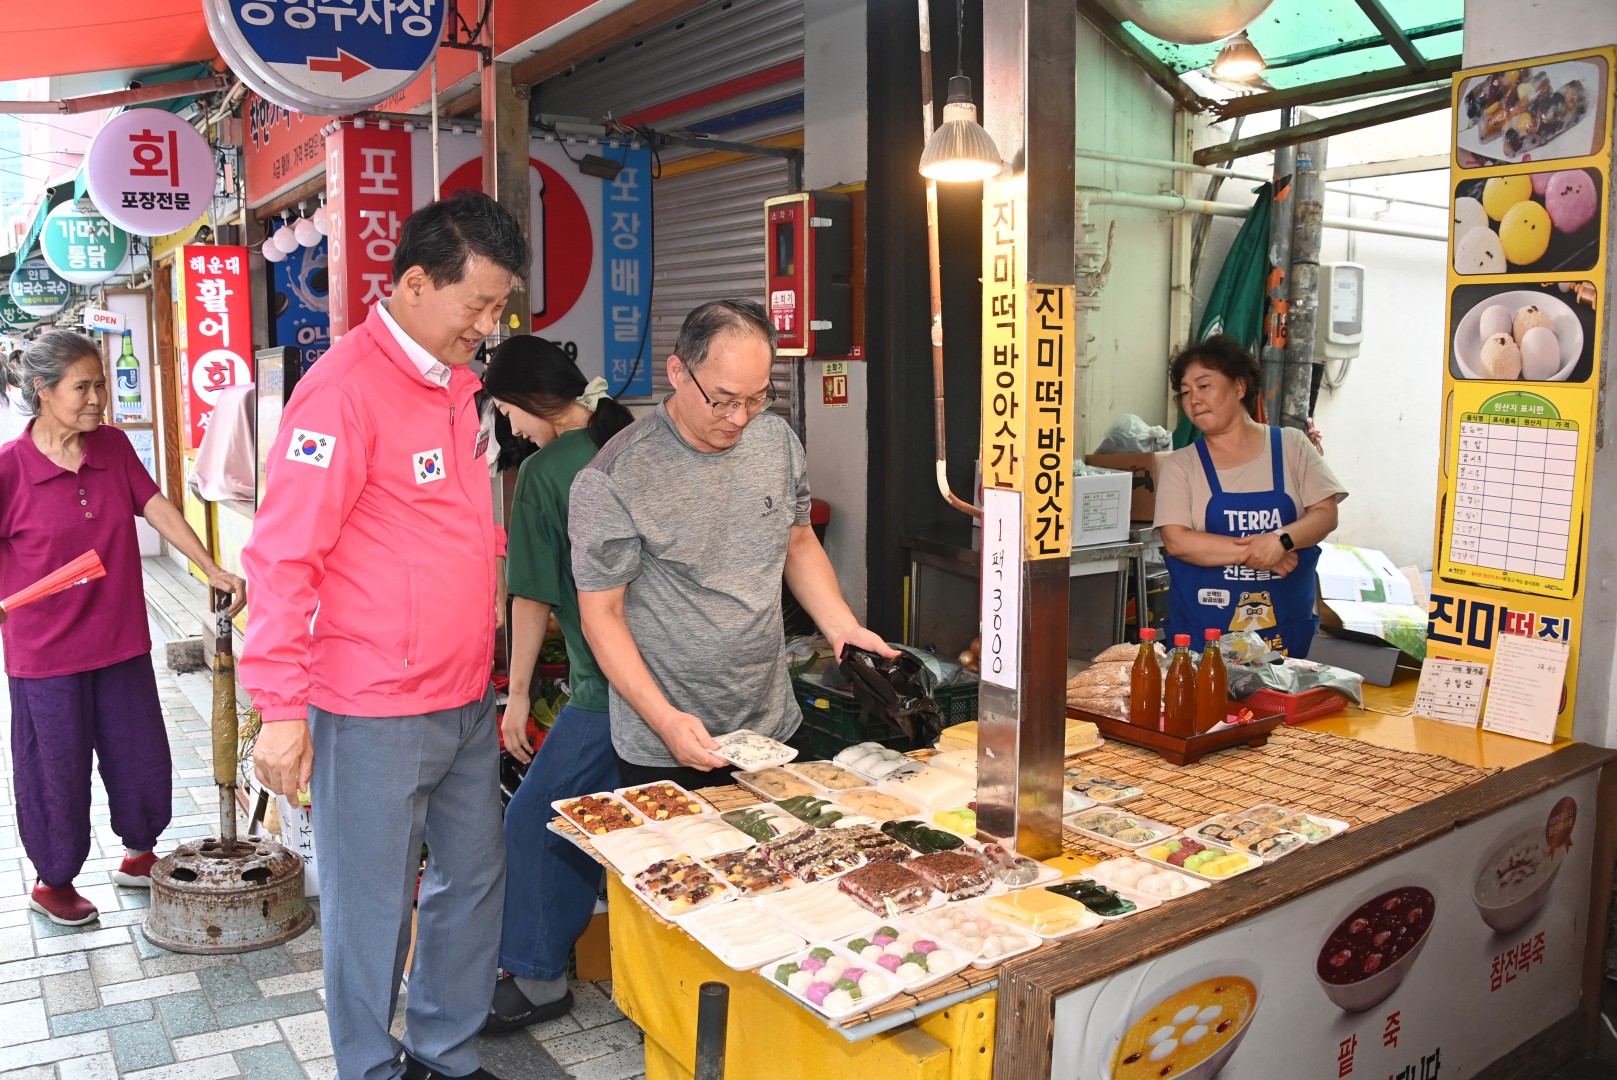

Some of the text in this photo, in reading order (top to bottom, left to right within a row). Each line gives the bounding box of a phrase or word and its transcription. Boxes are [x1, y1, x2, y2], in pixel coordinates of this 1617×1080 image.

[129, 128, 180, 187] 회
[121, 191, 191, 211] 포장전문
[771, 209, 794, 220] 소화기
[56, 219, 115, 245] 가마치
[67, 244, 107, 269] 통닭
[329, 149, 343, 342] 포장전
[610, 167, 642, 342] 포장배달
[28, 269, 50, 281] 안동
[189, 255, 240, 275] 해운대
[773, 292, 793, 304] 소화기
[93, 314, 117, 325] OPEN
[195, 278, 234, 348] 활어
[991, 199, 1019, 488] 진미떡방앗간
[202, 358, 236, 393] 회
[826, 362, 843, 372] 소화기
[1494, 402, 1545, 415] 원산지 표시판
[1034, 287, 1065, 555] 진미떡방앗간
[1523, 418, 1542, 427] 원산지
[1224, 508, 1283, 531] TERRA
[1444, 677, 1473, 689] 수입산
[1490, 930, 1546, 992] 참전복죽
